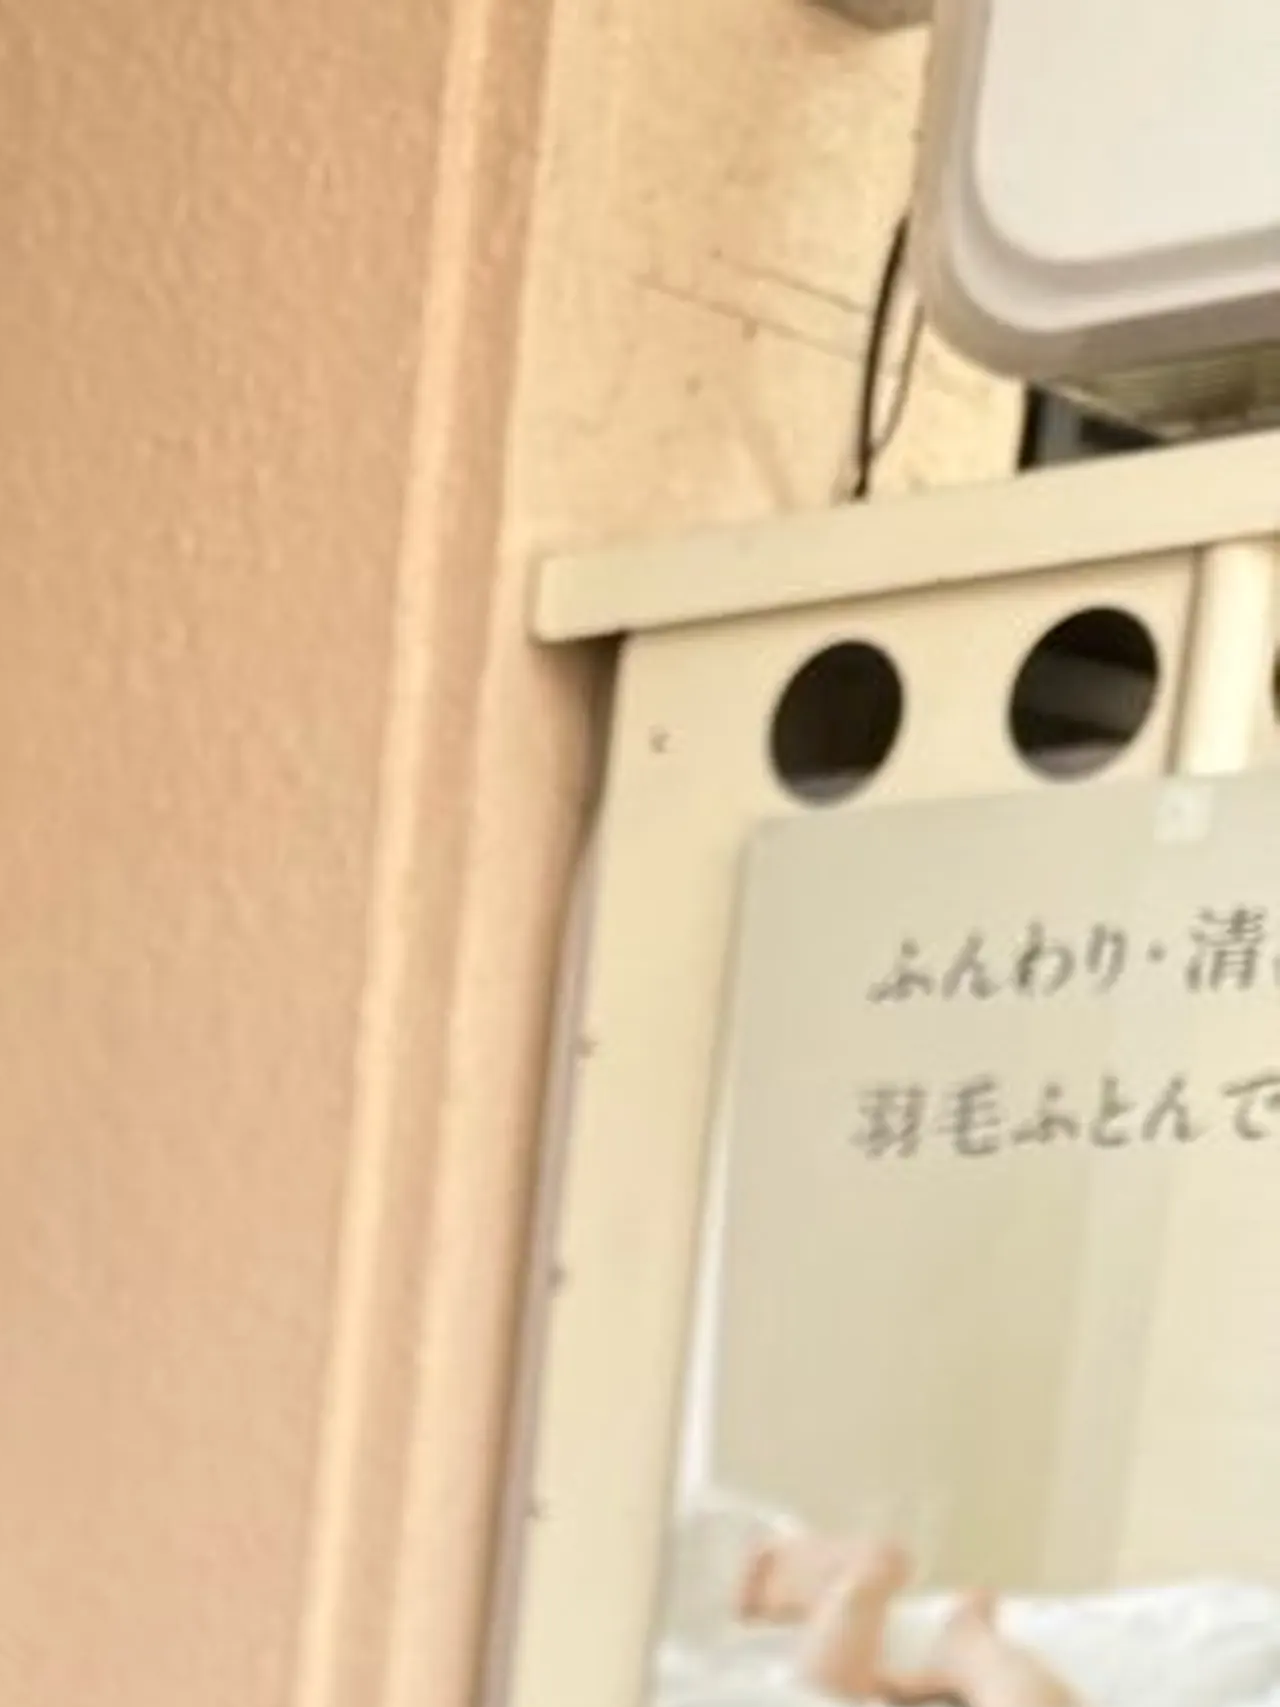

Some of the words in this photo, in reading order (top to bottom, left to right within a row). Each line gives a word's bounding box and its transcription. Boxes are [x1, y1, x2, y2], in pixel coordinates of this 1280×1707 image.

[864, 903, 1280, 1003] ふんわり・清
